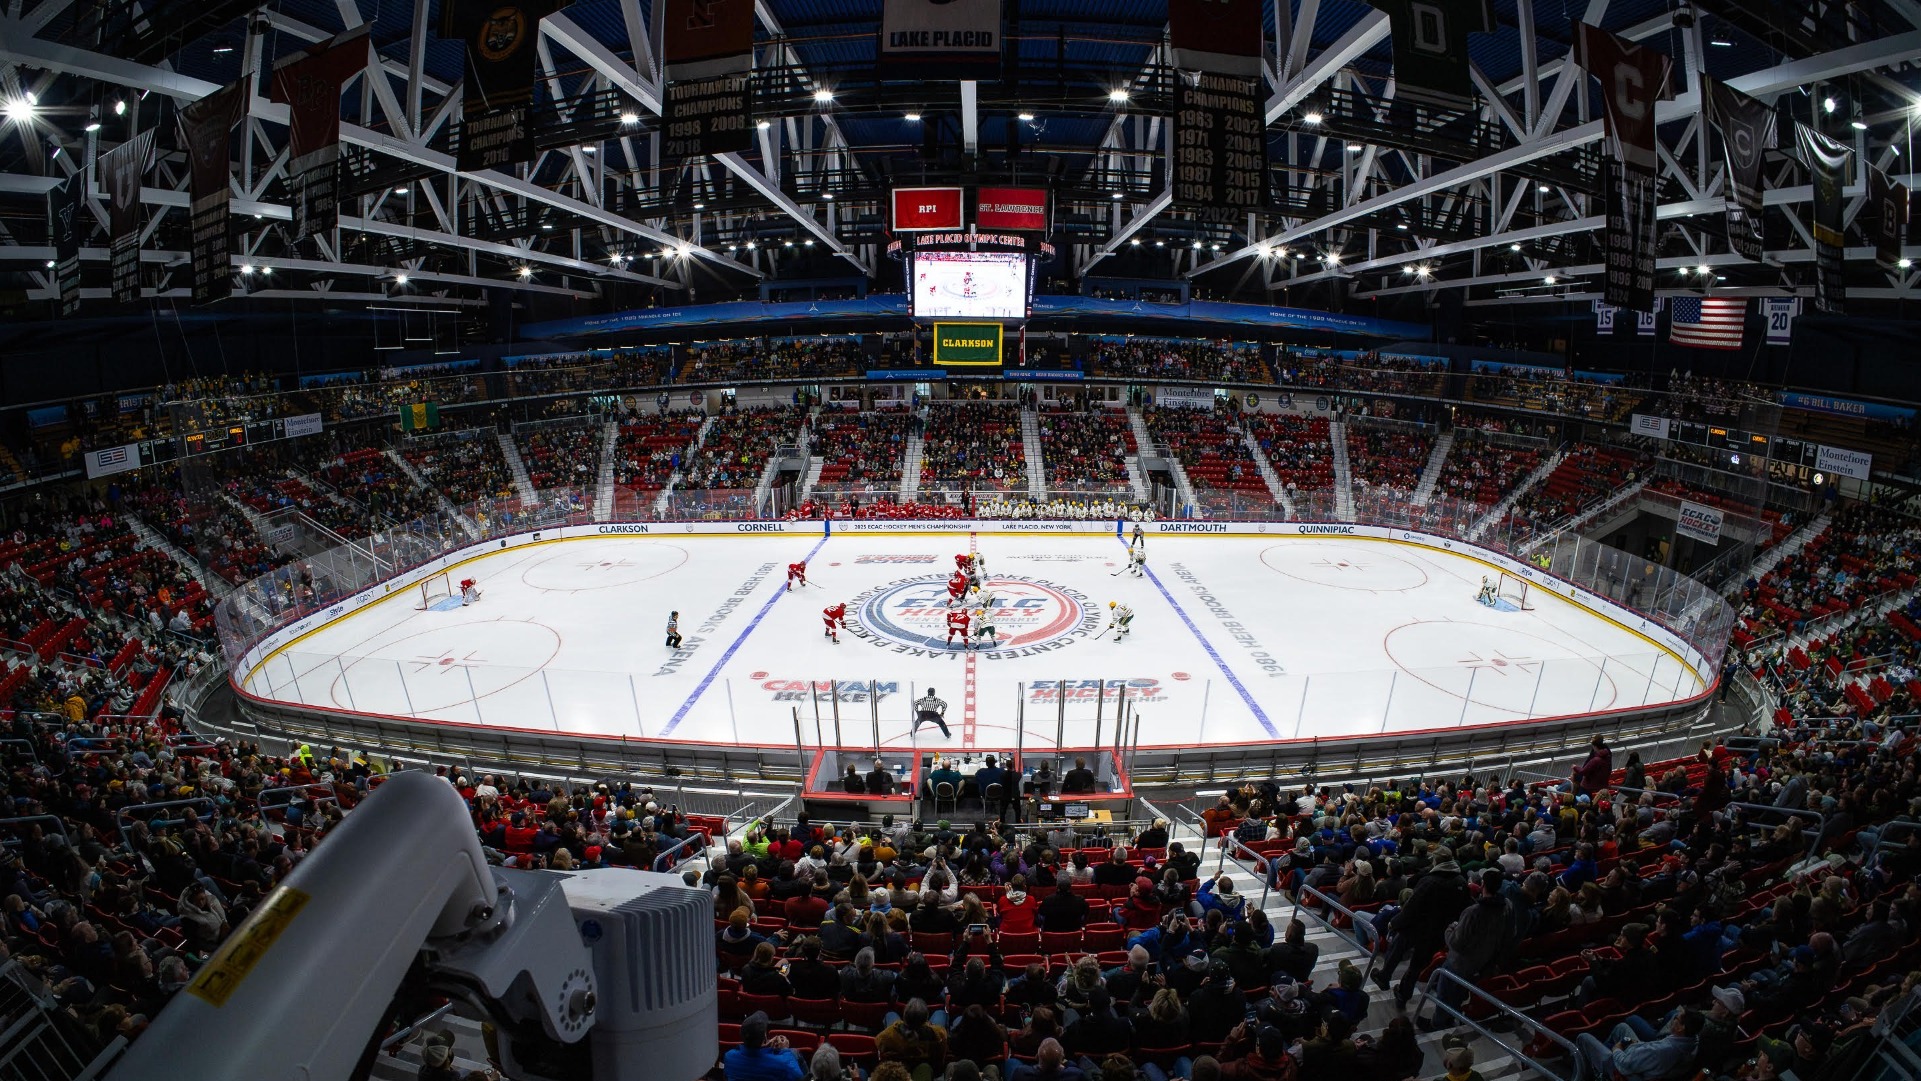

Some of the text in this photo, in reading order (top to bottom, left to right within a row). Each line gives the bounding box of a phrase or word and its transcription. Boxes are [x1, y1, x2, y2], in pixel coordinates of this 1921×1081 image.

[890, 31, 992, 47] LAKE PLACID
[669, 77, 747, 101] TOURNAMENT
[1613, 60, 1646, 121] C
[674, 96, 743, 118] CHAMPIONS
[1183, 90, 1255, 114] CHAMPIONS
[668, 114, 745, 138] 1998 2008
[1224, 115, 1260, 134] 2002
[1178, 129, 1261, 153] 1971 2004
[1178, 147, 1263, 170] 1983 2006
[1178, 165, 1260, 188] 1987 2015
[1178, 183, 1260, 205] 1994 2017
[918, 204, 937, 213] RPI
[979, 203, 1044, 214] ST. LAWRENCE
[59, 201, 75, 242] Y
[917, 233, 1025, 248] LAKE PLACID OLYMPIC CENTER
[1600, 310, 1612, 325] 15
[1640, 311, 1653, 325] 16
[1771, 312, 1788, 330] 20
[942, 338, 994, 348] CLARKSON
[1163, 387, 1210, 398] Montefiore
[1163, 398, 1197, 408] Einstein
[1811, 397, 1831, 409] BILL
[1833, 401, 1866, 414] BAKER
[286, 415, 321, 427] Montefiore
[286, 426, 313, 437] Einstein
[1820, 447, 1870, 467] Montefiore
[1818, 459, 1854, 476] Einstein
[1680, 515, 1720, 533] HOCKEY
[1681, 508, 1713, 522] ECAC
[599, 524, 649, 534] CLARKSON
[738, 523, 785, 533] CORNELL
[1160, 523, 1227, 533] DARTMOUTH
[1298, 524, 1355, 535] QUINNIPIAC
[1678, 524, 1718, 539] CHAMPIONSHIP
[734, 576, 766, 596] HERB
[1034, 579, 1088, 600] PLACID
[1189, 586, 1234, 618] BROOKS
[696, 597, 745, 633] BROOKS
[1071, 601, 1101, 638] OLYMPIC
[1222, 621, 1263, 648] HERB
[651, 636, 707, 677] ARENA
[891, 644, 958, 660] LAKE
[984, 637, 1075, 660] CENTER
[1250, 651, 1288, 677] 1980
[1028, 680, 1128, 689] ECAC
[1030, 687, 1162, 698] HOCKEY
